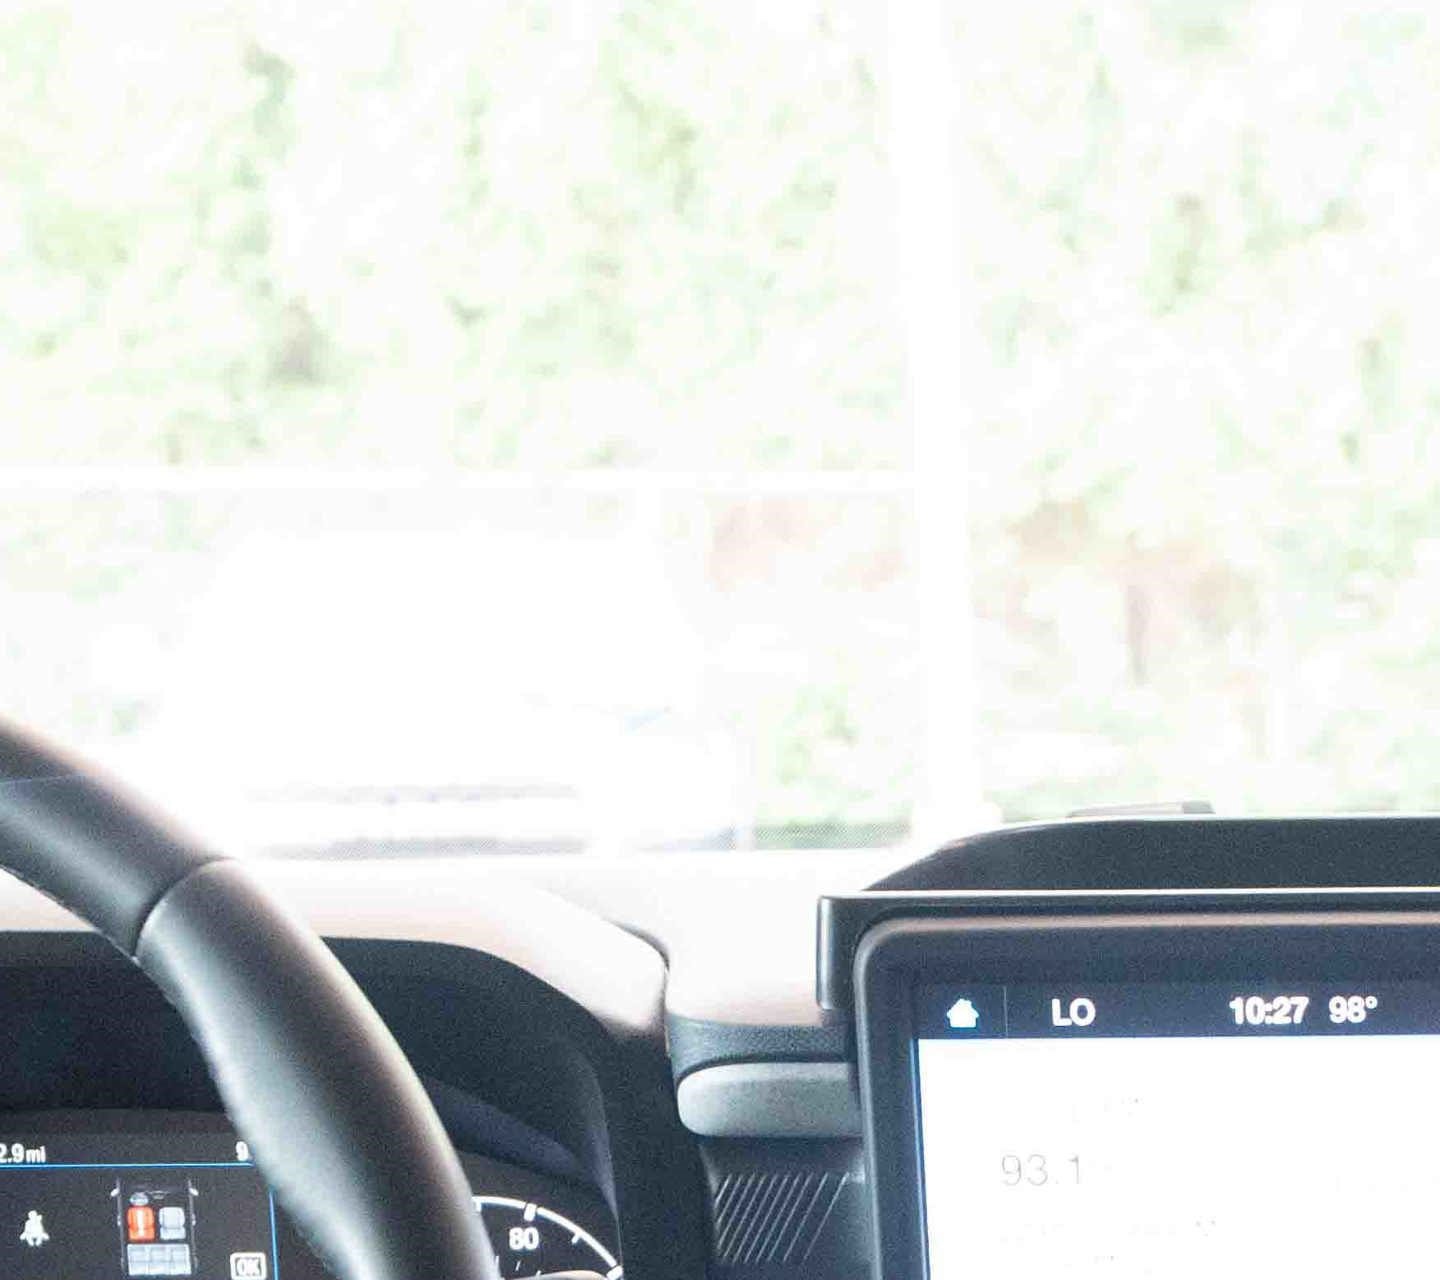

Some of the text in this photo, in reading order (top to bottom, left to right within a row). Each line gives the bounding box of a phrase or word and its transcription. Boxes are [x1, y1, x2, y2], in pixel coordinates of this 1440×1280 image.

[1051, 998, 1096, 1026] LO
[1229, 996, 1309, 1025] 10:27
[1001, 1152, 1080, 1187] 93.1
[509, 1227, 539, 1250] 80
